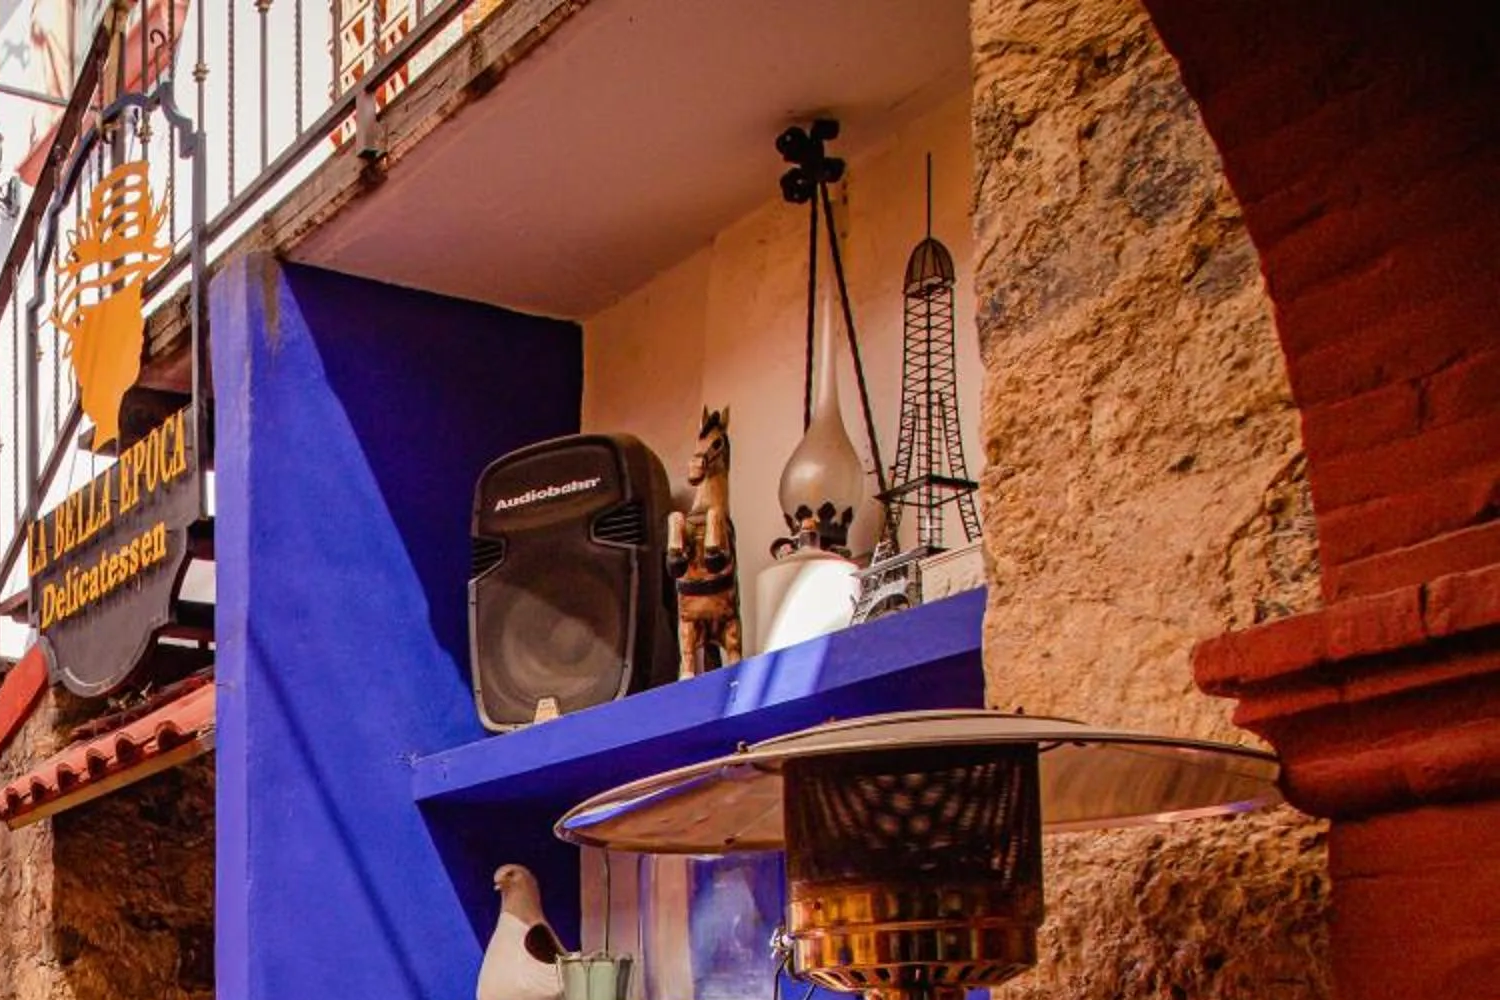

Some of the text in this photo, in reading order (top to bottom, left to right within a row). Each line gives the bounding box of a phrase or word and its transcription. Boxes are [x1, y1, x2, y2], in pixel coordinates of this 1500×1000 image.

[28, 409, 186, 577] LA BELLA EPOCA
[494, 477, 598, 512] Audiobahn
[41, 522, 167, 628] Delicatessen
